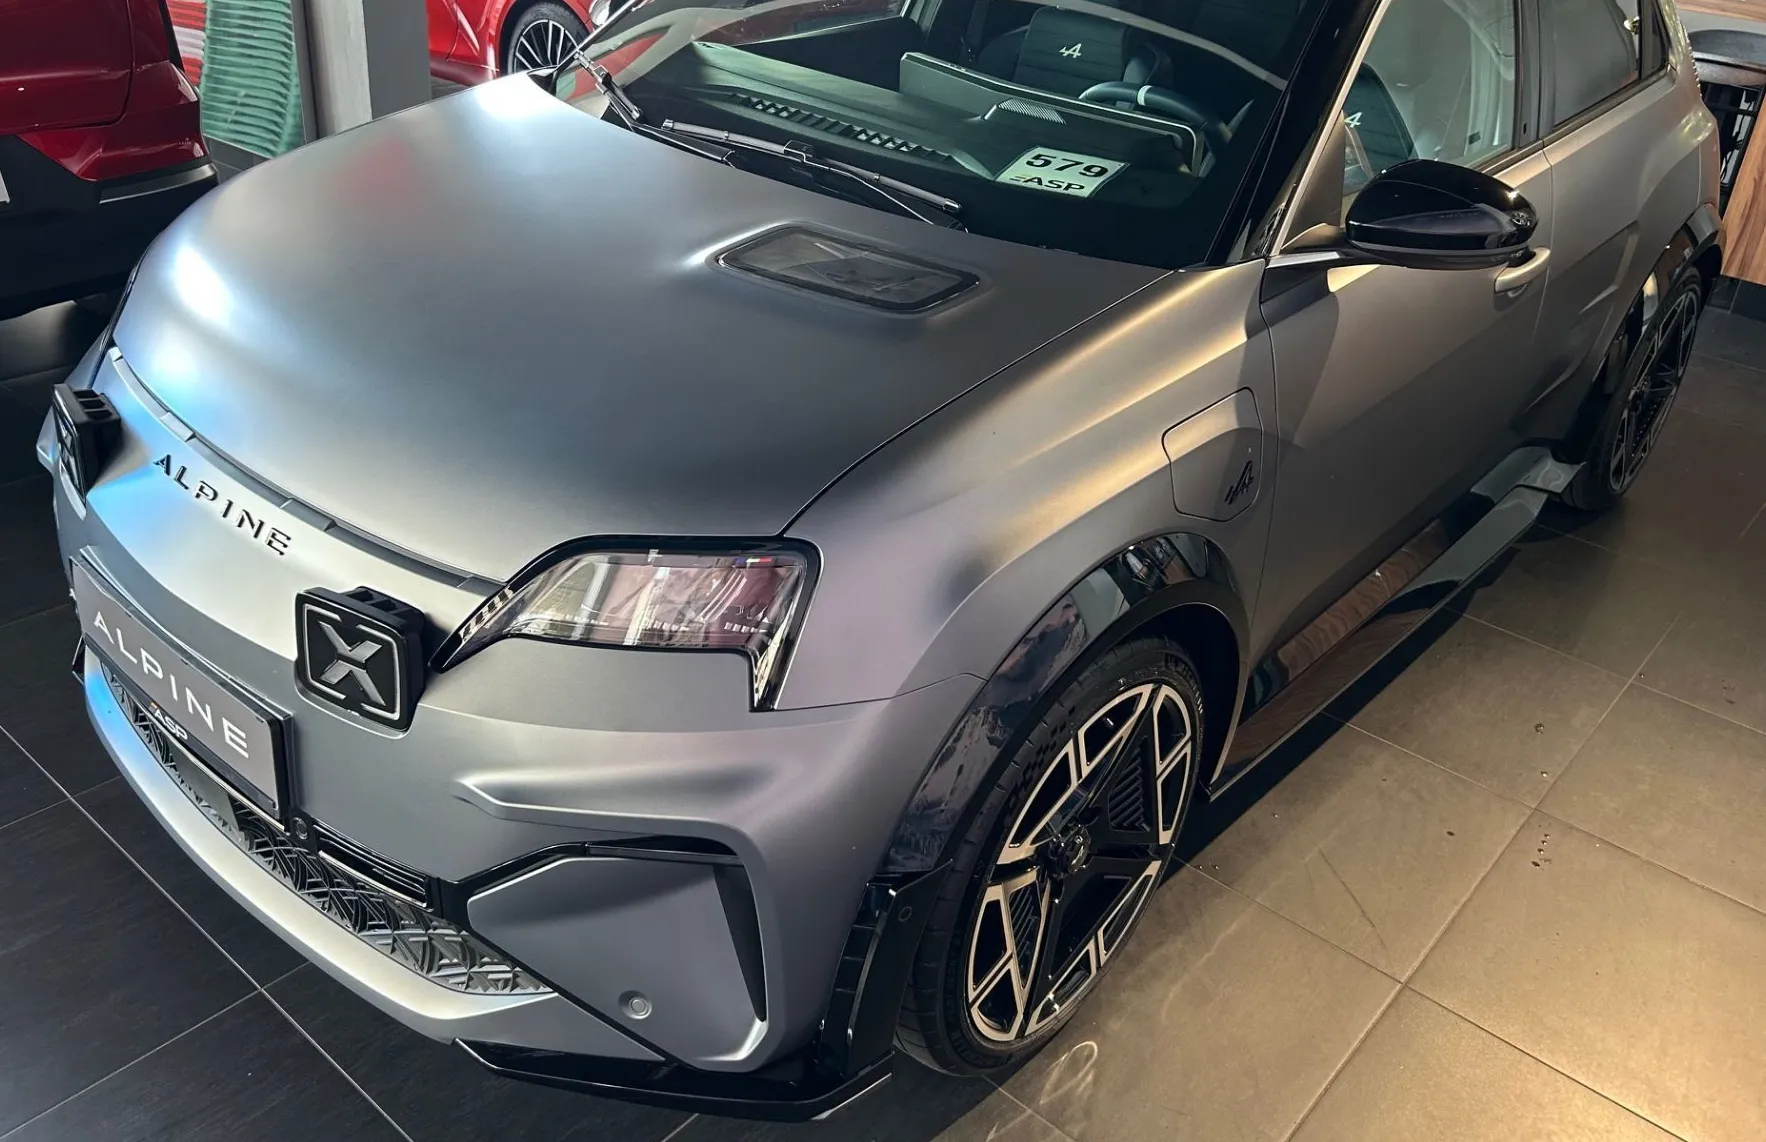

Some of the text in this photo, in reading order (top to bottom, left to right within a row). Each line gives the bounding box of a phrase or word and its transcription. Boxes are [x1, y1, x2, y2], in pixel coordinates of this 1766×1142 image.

[1026, 154, 1108, 177] 579
[1022, 176, 1085, 190] ASP
[153, 454, 291, 556] ALPINE
[94, 611, 249, 758] ALPINE
[154, 709, 189, 740] ASP
